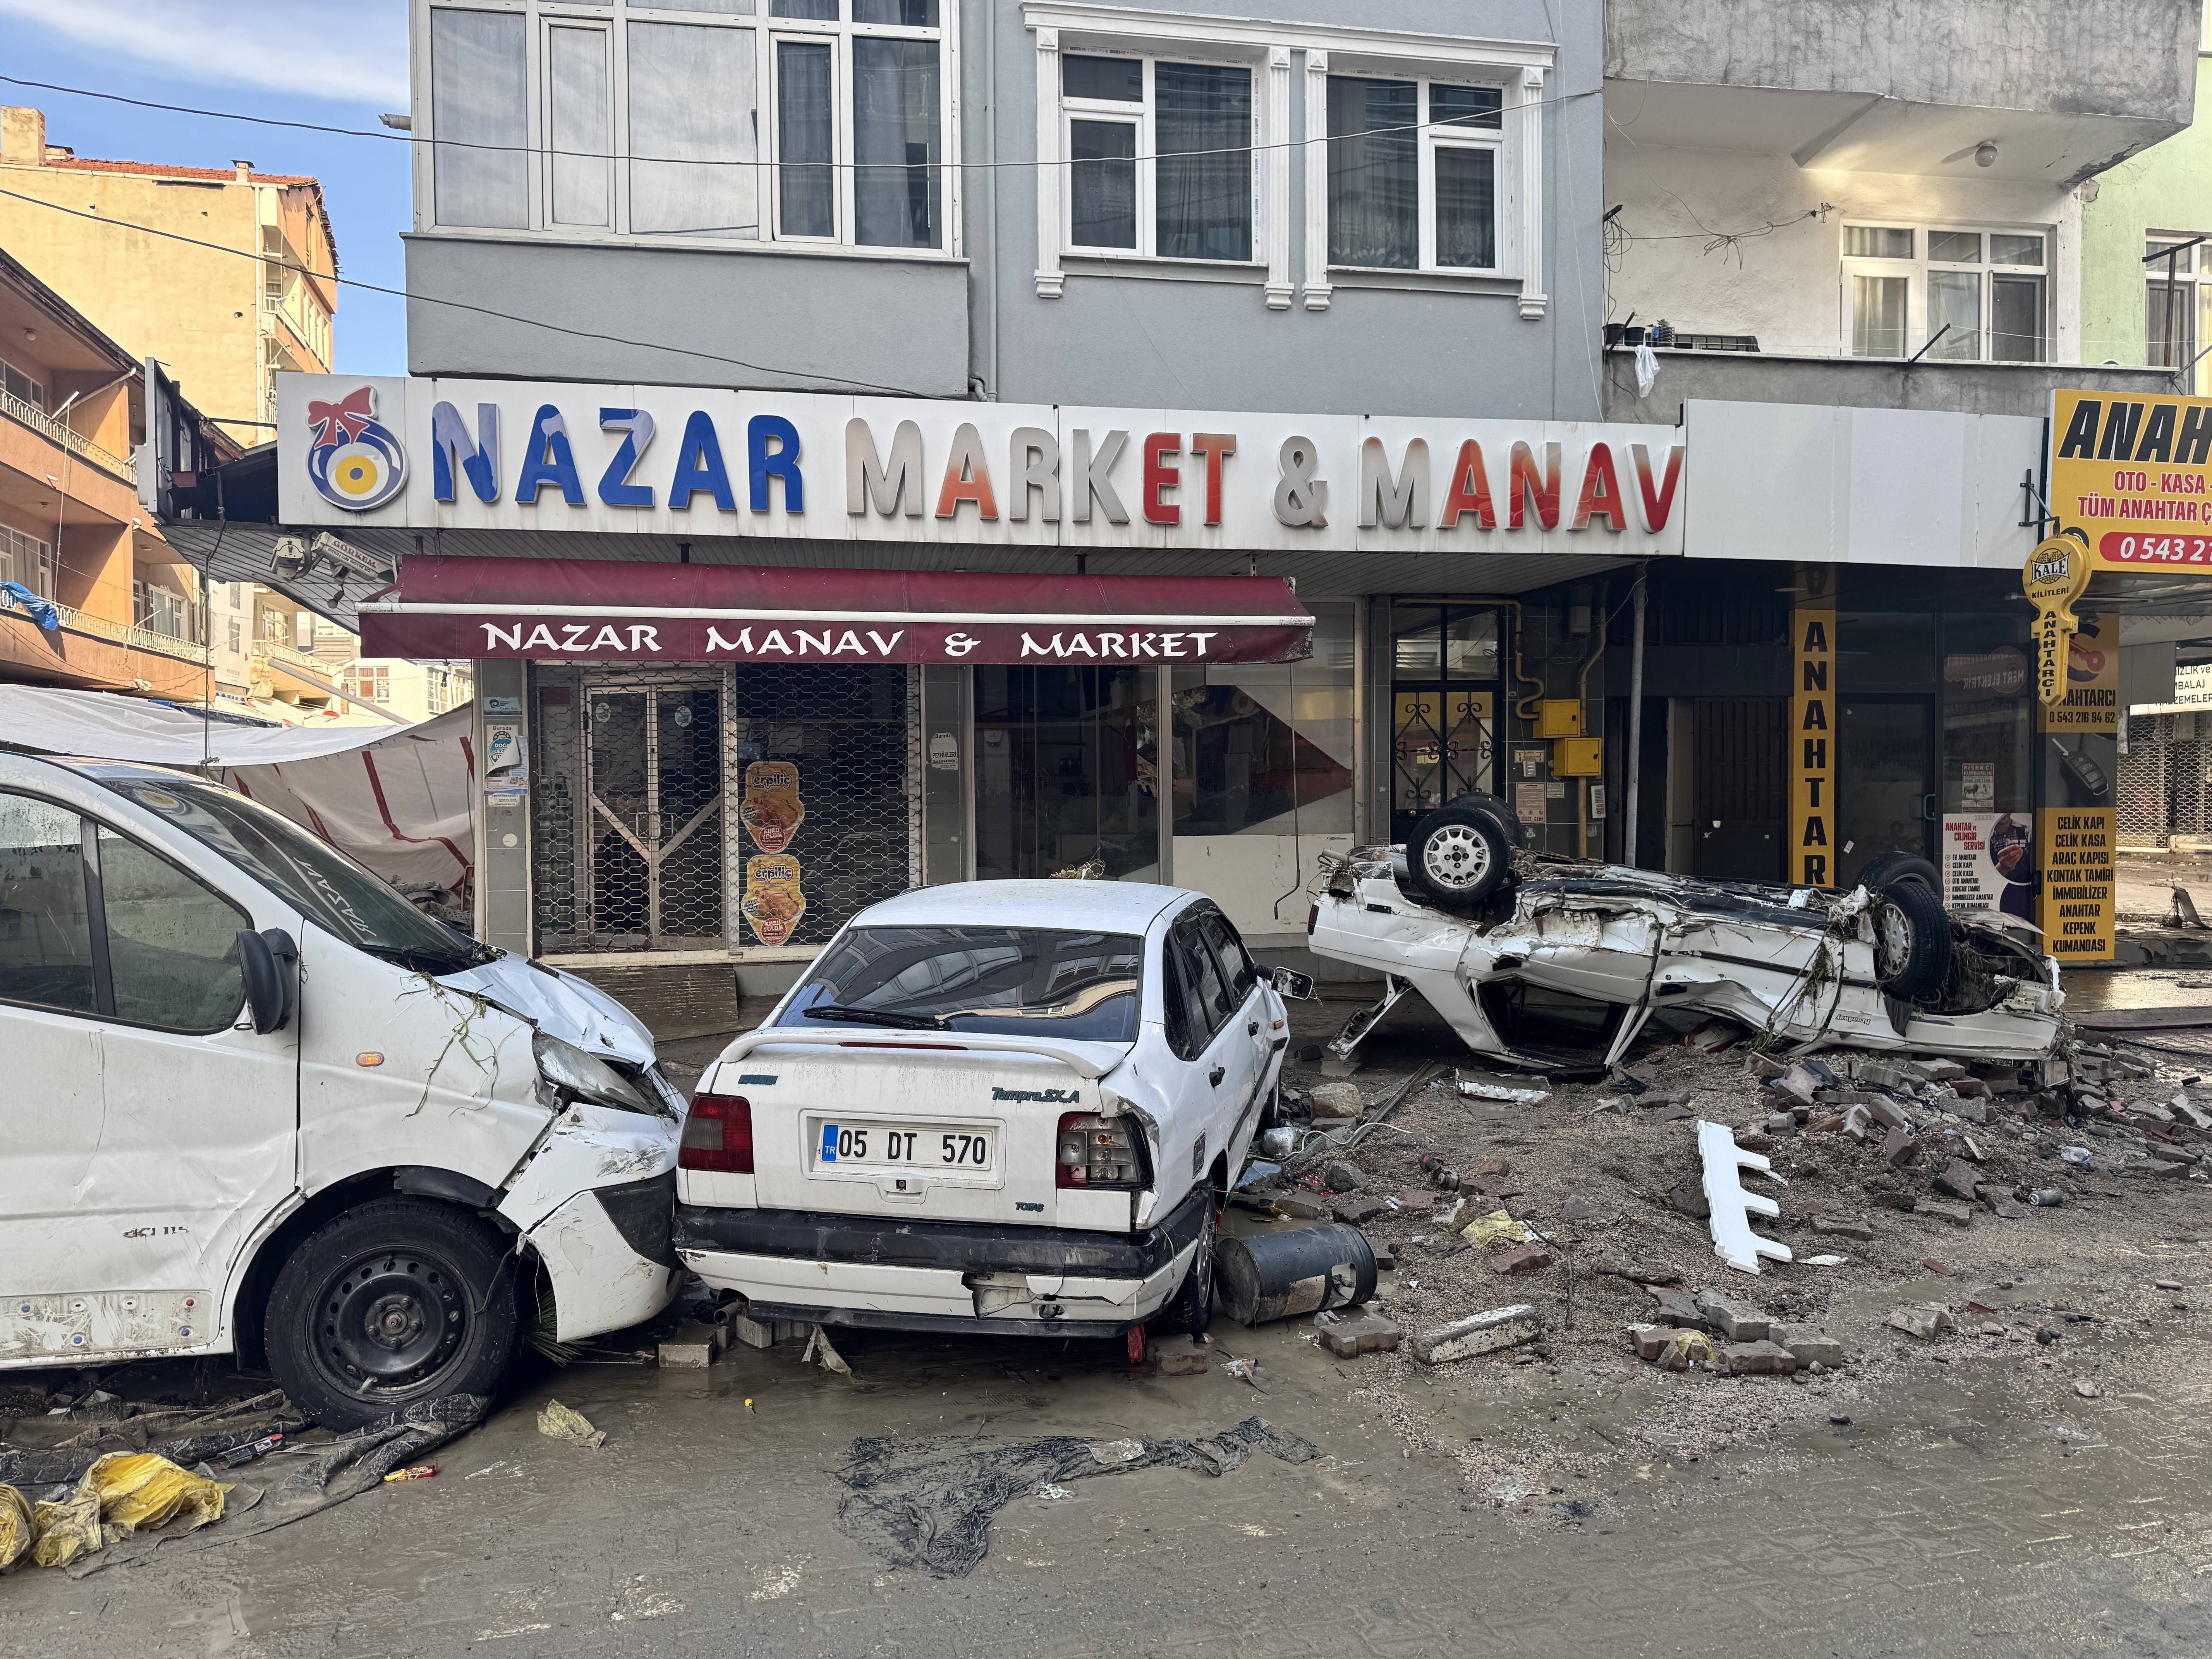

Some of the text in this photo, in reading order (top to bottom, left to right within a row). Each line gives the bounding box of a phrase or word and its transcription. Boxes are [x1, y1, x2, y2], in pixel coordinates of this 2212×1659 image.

[432, 401, 1686, 534] NAZAR MARKET & MANAV
[2114, 470, 2147, 492] OTO
[2160, 472, 2206, 495] KASA
[2077, 493, 2115, 519] TÜM
[2118, 498, 2198, 522] ANAHTAR
[332, 540, 377, 568] GÖRKEM
[2120, 537, 2135, 559] 0
[2140, 538, 2185, 561] 543
[2033, 558, 2066, 580] KALE
[2032, 586, 2069, 599] KİLİTLERİ
[480, 622, 1219, 658] NAZAR MANAV & MARKET
[2042, 611, 2056, 697] ANAHTARCI
[2058, 689, 2116, 706] AHTARCI
[2049, 711, 2115, 723] 0 543 216 94 62
[1803, 622, 1828, 885] ANAHTAR
[753, 773, 792, 789] erpiliç
[1946, 822, 1972, 831] ANAHTAR
[2057, 815, 2105, 830] ÇELİK KAPI
[1964, 840, 1985, 850] SERVİSİ
[2055, 832, 2106, 848] ÇELİK KASA
[2052, 852, 2109, 866] ARAÇ KAPISI
[754, 865, 793, 881] erpiliç
[2047, 867, 2113, 883] KONTAK TAMİRİ
[2052, 885, 2107, 900] İMMOBİLİZER
[2059, 904, 2100, 918] ANAHTAR
[2063, 921, 2096, 935] KEPENK
[2052, 939, 2106, 953] KUMANDASI
[1836, 1014, 1871, 1025] Broadway
[992, 1087, 1041, 1103] Tempra
[825, 1146, 835, 1154] TR
[839, 1130, 986, 1164] 05 DT 570
